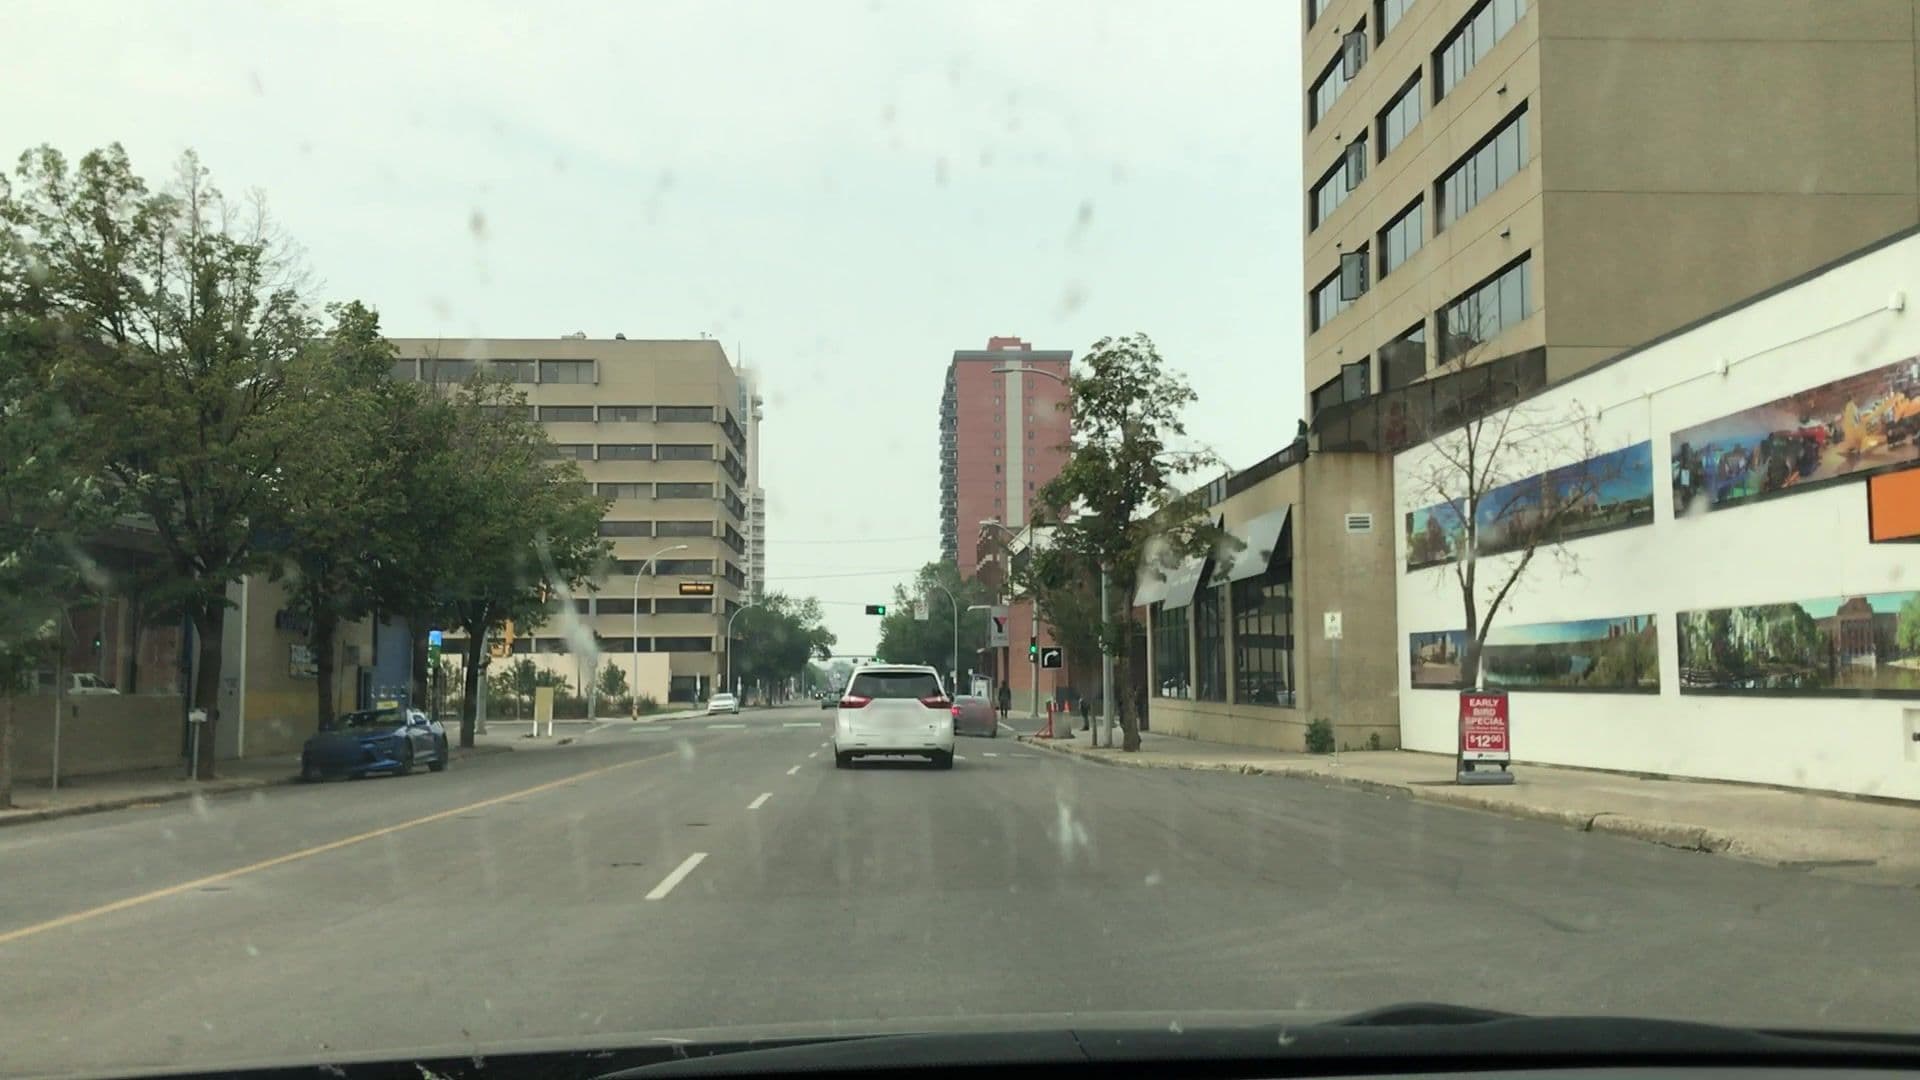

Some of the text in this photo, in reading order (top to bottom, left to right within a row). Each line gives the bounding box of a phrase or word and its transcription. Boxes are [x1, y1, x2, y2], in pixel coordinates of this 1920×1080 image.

[1469, 698, 1500, 707] EARLY
[1473, 708, 1496, 716] BIRD
[1464, 717, 1505, 726] SPECIAL
